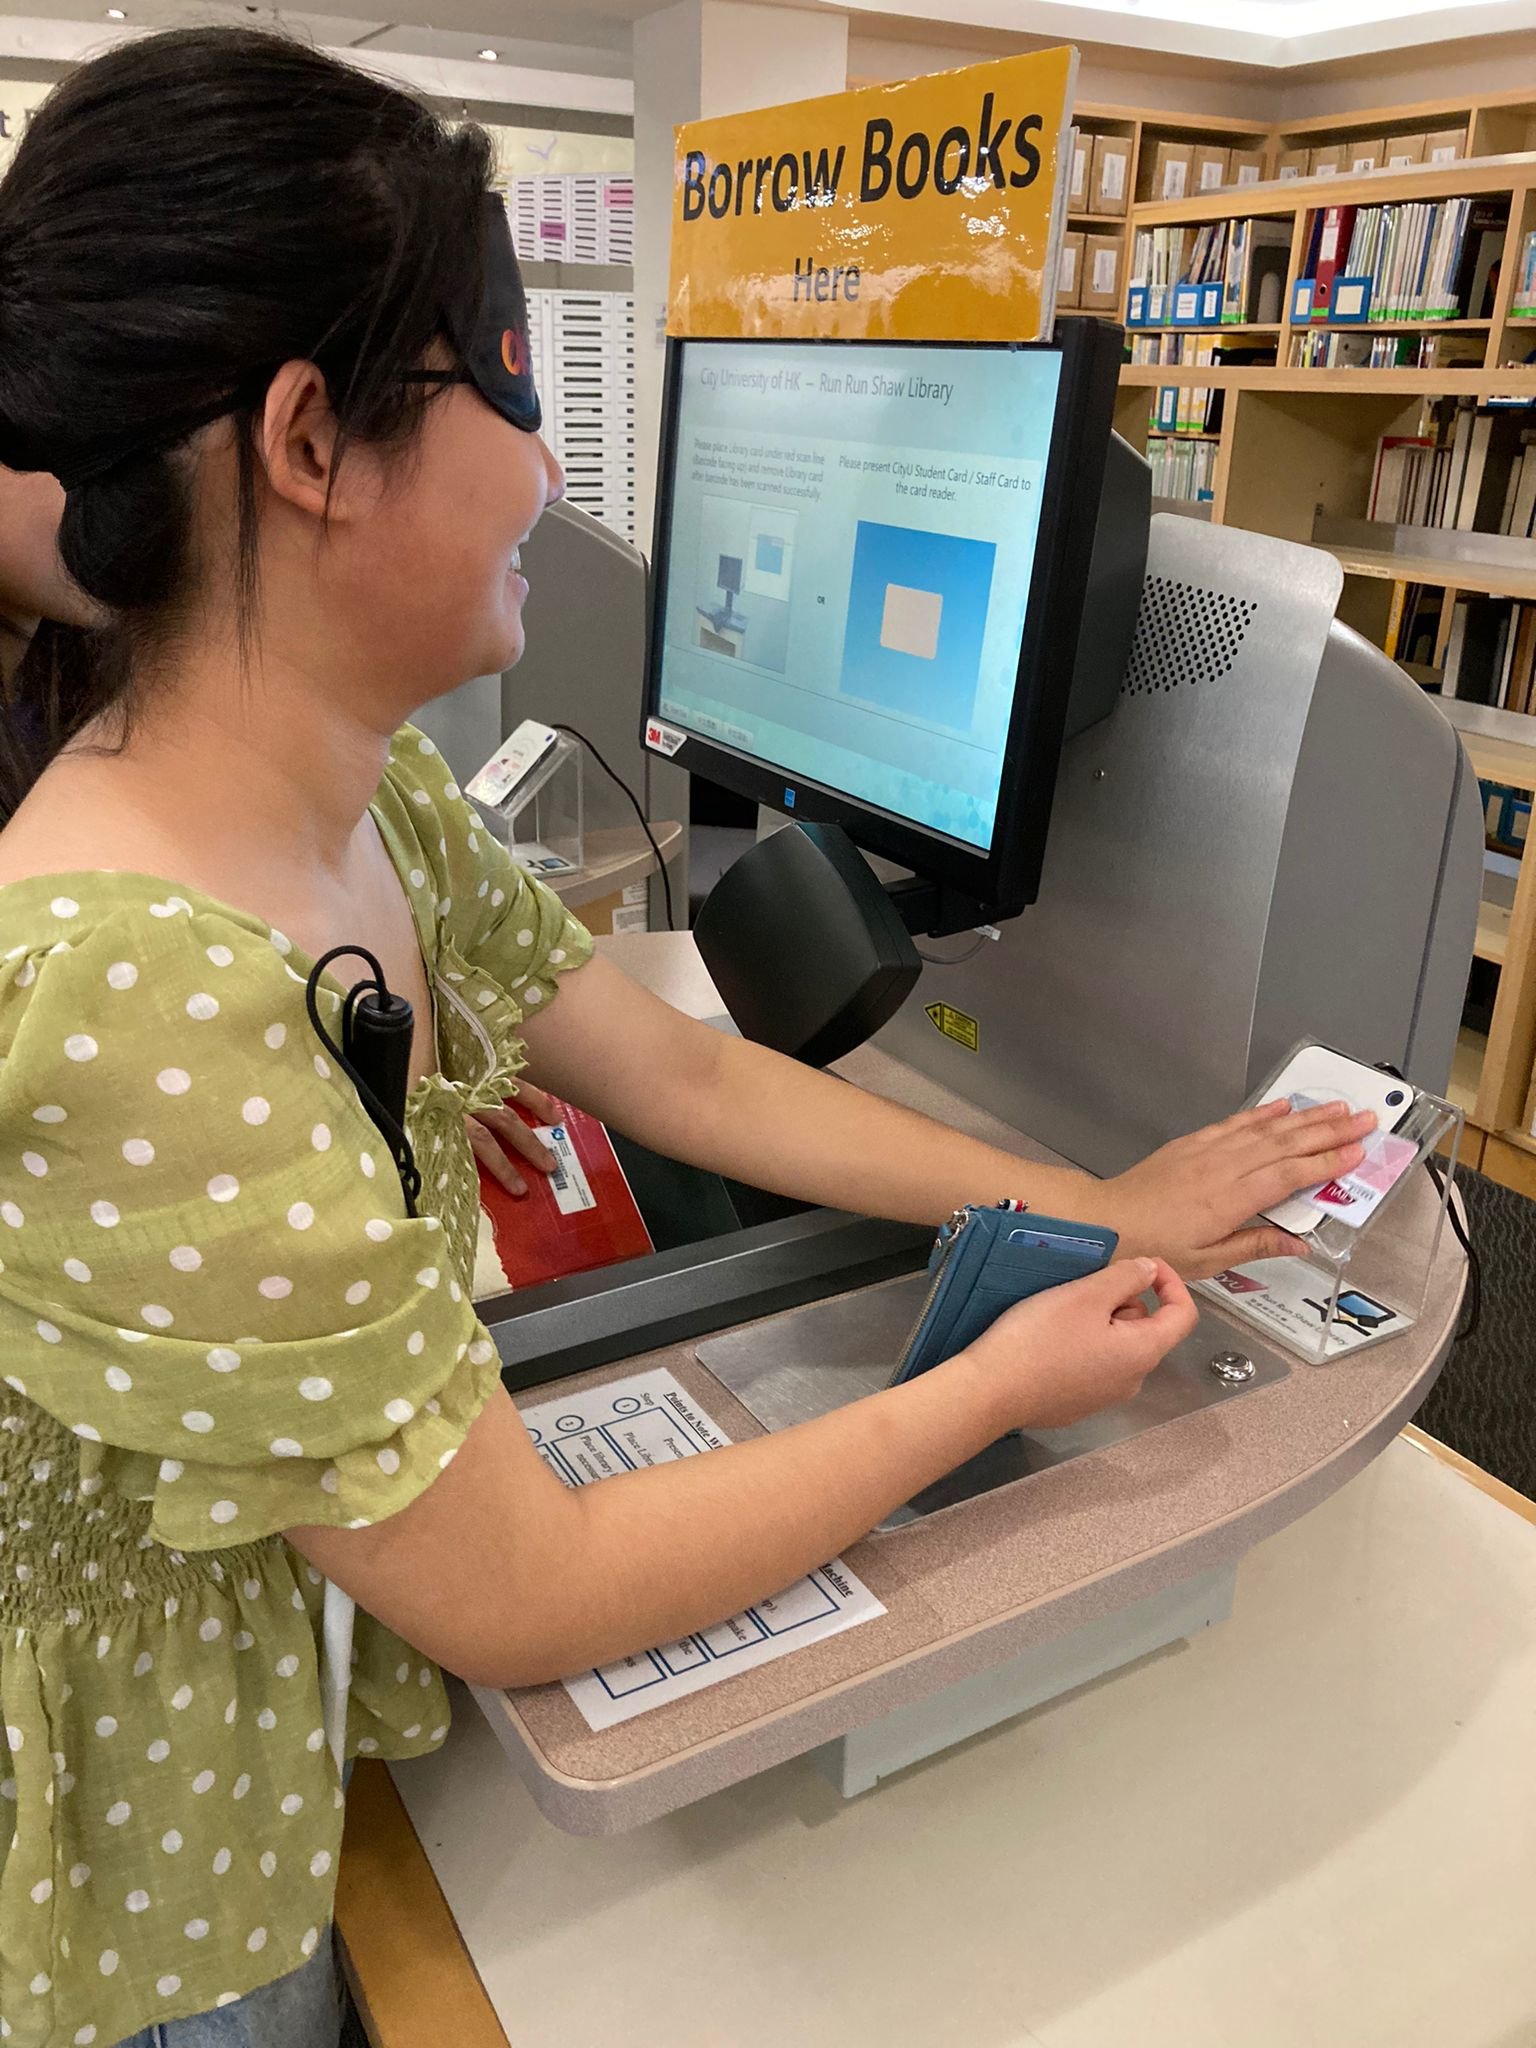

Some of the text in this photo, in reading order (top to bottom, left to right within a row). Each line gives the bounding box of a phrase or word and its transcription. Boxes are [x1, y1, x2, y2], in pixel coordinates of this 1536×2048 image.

[684, 144, 846, 221] Borrow
[859, 92, 1043, 203] Books
[793, 257, 860, 302] Here
[701, 368, 719, 390] City
[721, 368, 768, 394] University
[770, 370, 783, 389] of
[784, 371, 801, 391] HK
[819, 372, 842, 393] Run
[845, 374, 868, 395] Run
[871, 375, 905, 398] Shaw
[908, 376, 954, 407] Library
[750, 446, 763, 457] card
[765, 446, 783, 459] under
[796, 452, 811, 463] scan
[813, 452, 825, 465] line
[718, 457, 735, 472] facing
[748, 462, 760, 474] and
[761, 465, 784, 477] remove
[785, 465, 807, 482] Library
[808, 470, 823, 482] card
[839, 455, 861, 470] Please
[862, 461, 890, 475] present
[892, 462, 914, 478] CityU
[915, 465, 946, 480] Student
[947, 469, 968, 484] Card
[975, 472, 998, 487] Staff
[997, 474, 1020, 489] Card
[1021, 477, 1032, 491] to
[729, 475, 739, 487] has
[740, 477, 755, 489] been
[757, 480, 782, 493] scanned
[783, 485, 822, 503] successfully.
[895, 481, 957, 502] the card reader.
[647, 727, 661, 744] 3M
[1260, 1293, 1277, 1305] Run
[1277, 1303, 1294, 1315] Run
[1294, 1312, 1314, 1328] Shaw
[640, 1392, 655, 1407] Step
[666, 1391, 689, 1414] Points
[685, 1413, 696, 1422] to
[691, 1420, 711, 1438] Note
[624, 1431, 641, 1449] Place
[579, 1435, 613, 1474] Place library
[725, 1619, 747, 1642] make
[679, 1641, 693, 1656] the
